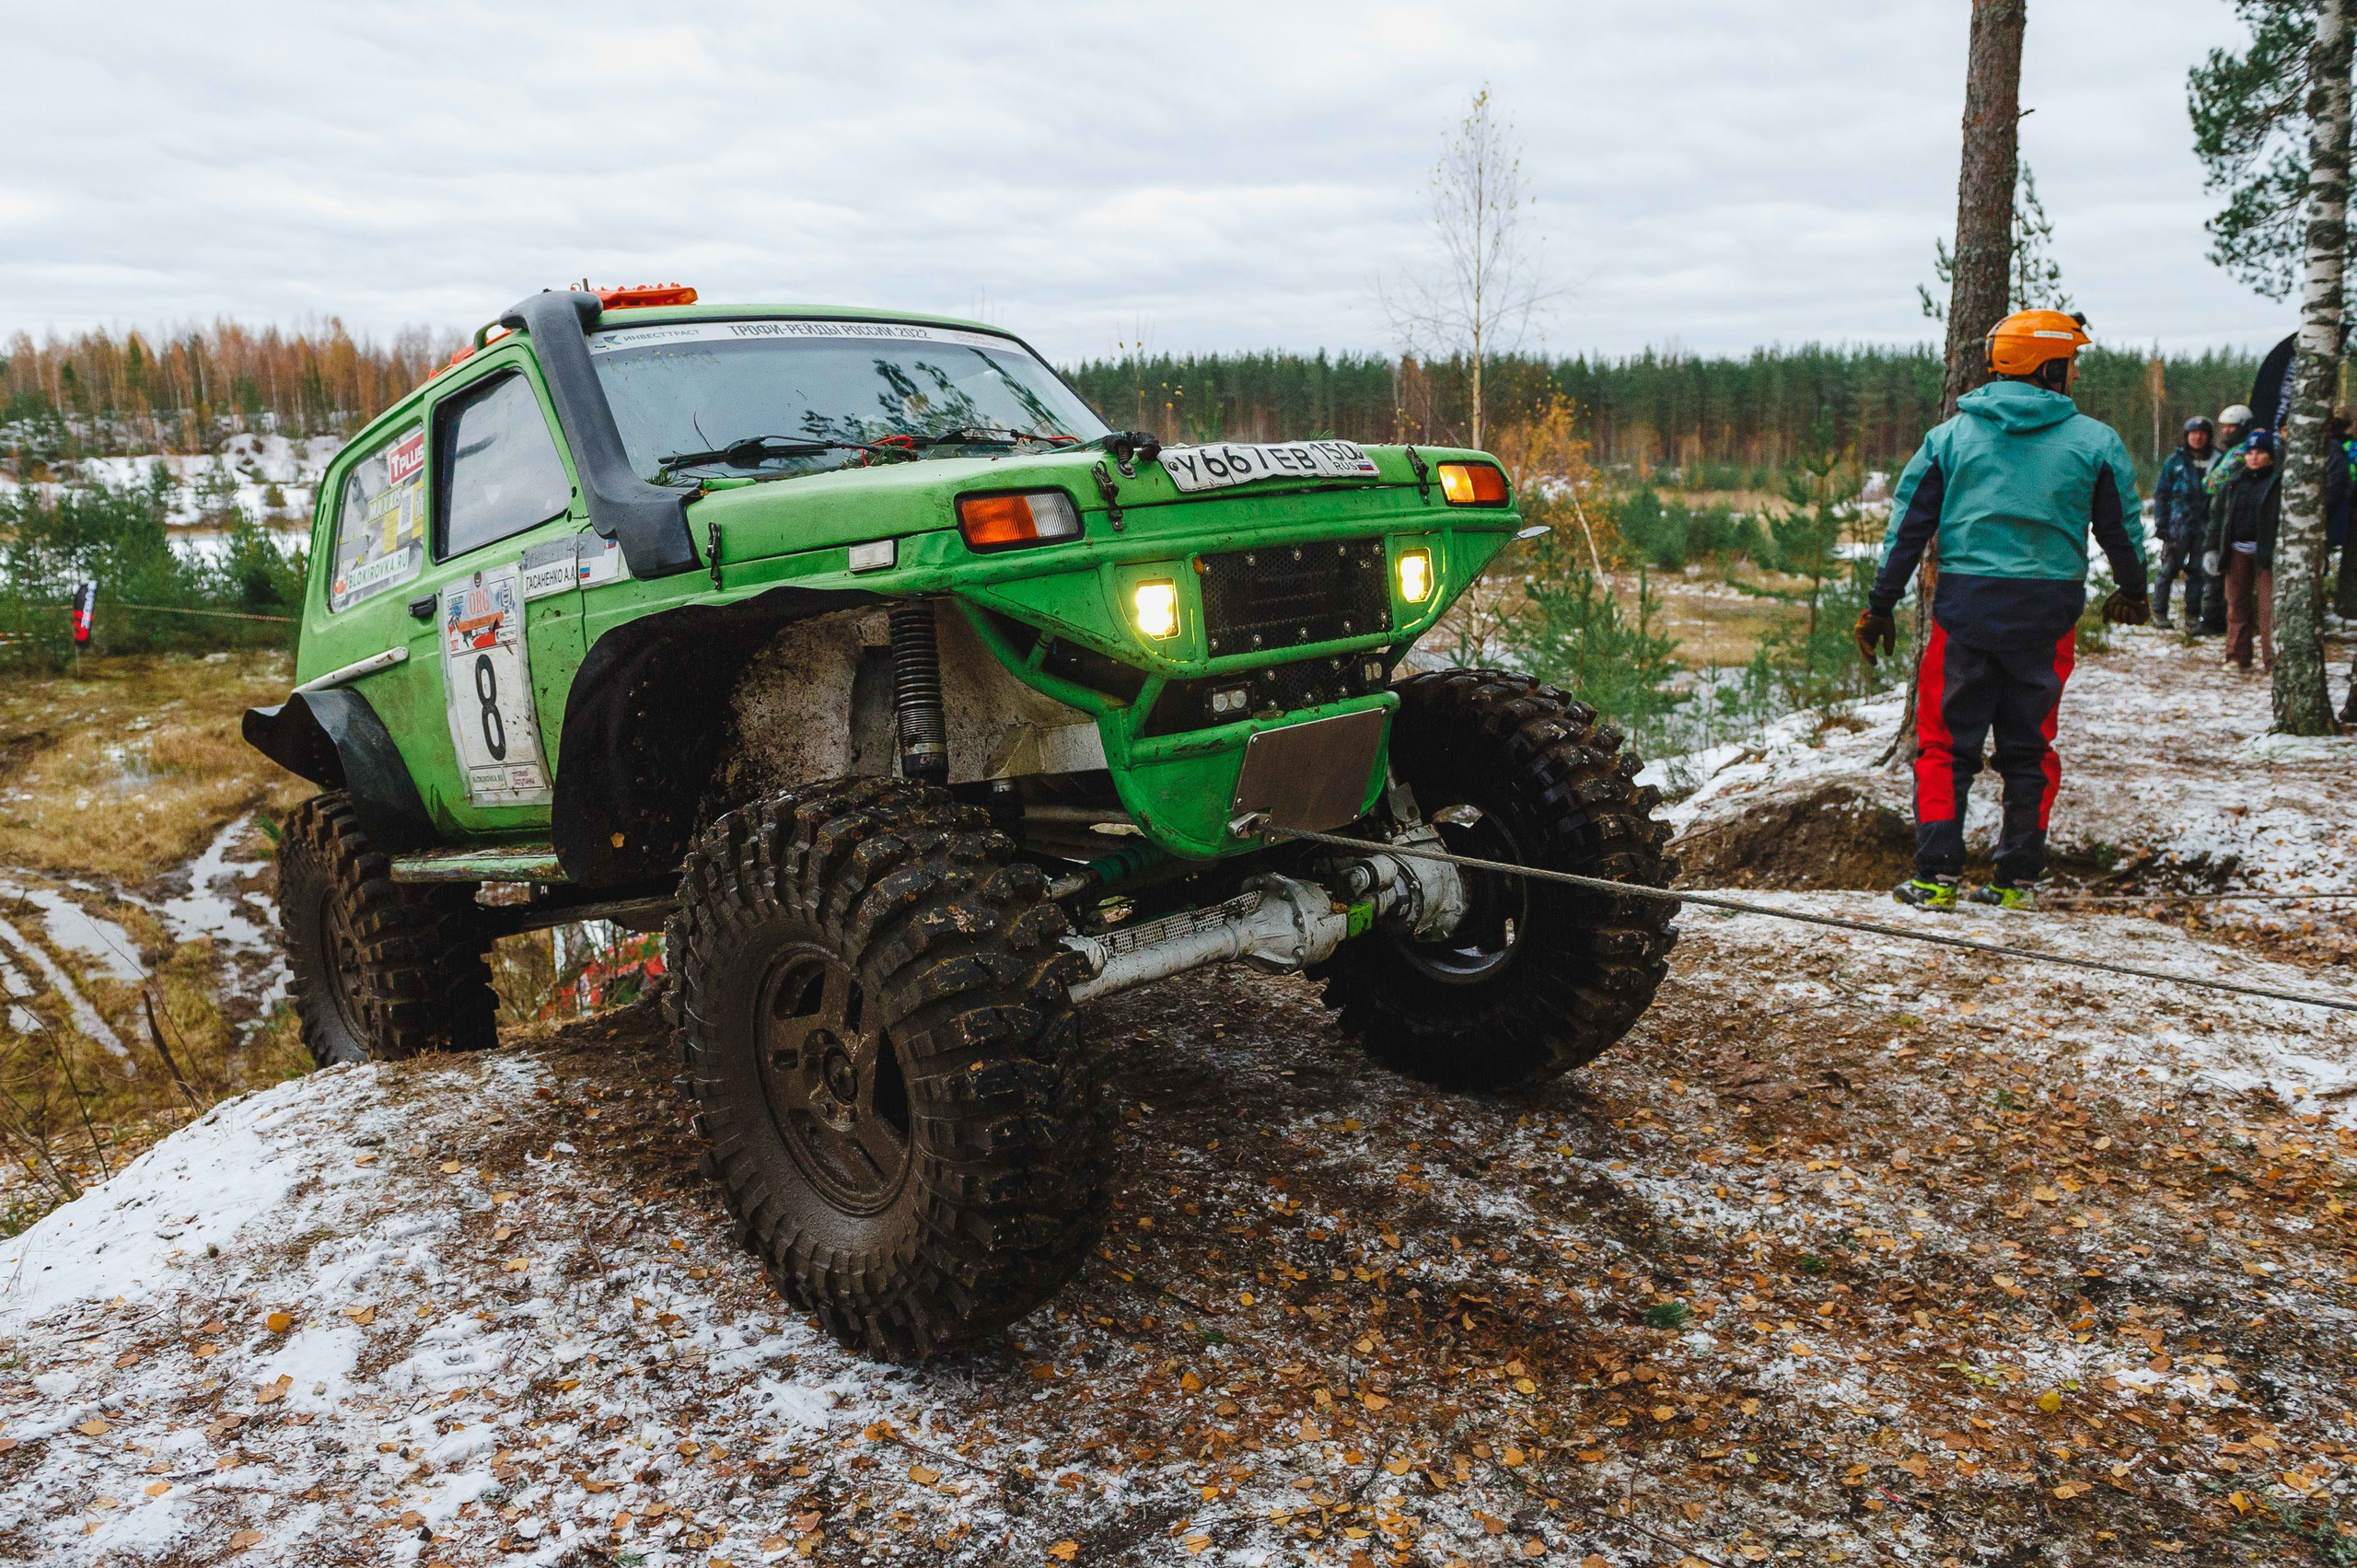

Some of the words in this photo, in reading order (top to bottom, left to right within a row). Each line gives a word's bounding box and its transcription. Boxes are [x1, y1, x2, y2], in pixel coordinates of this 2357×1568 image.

[622, 329, 701, 342] ИНВЕСТТРАСТ
[1333, 461, 1358, 470] RUS
[348, 551, 409, 589] BLOKIROVKA.RU
[469, 588, 490, 615] ORG
[475, 654, 506, 761] 8
